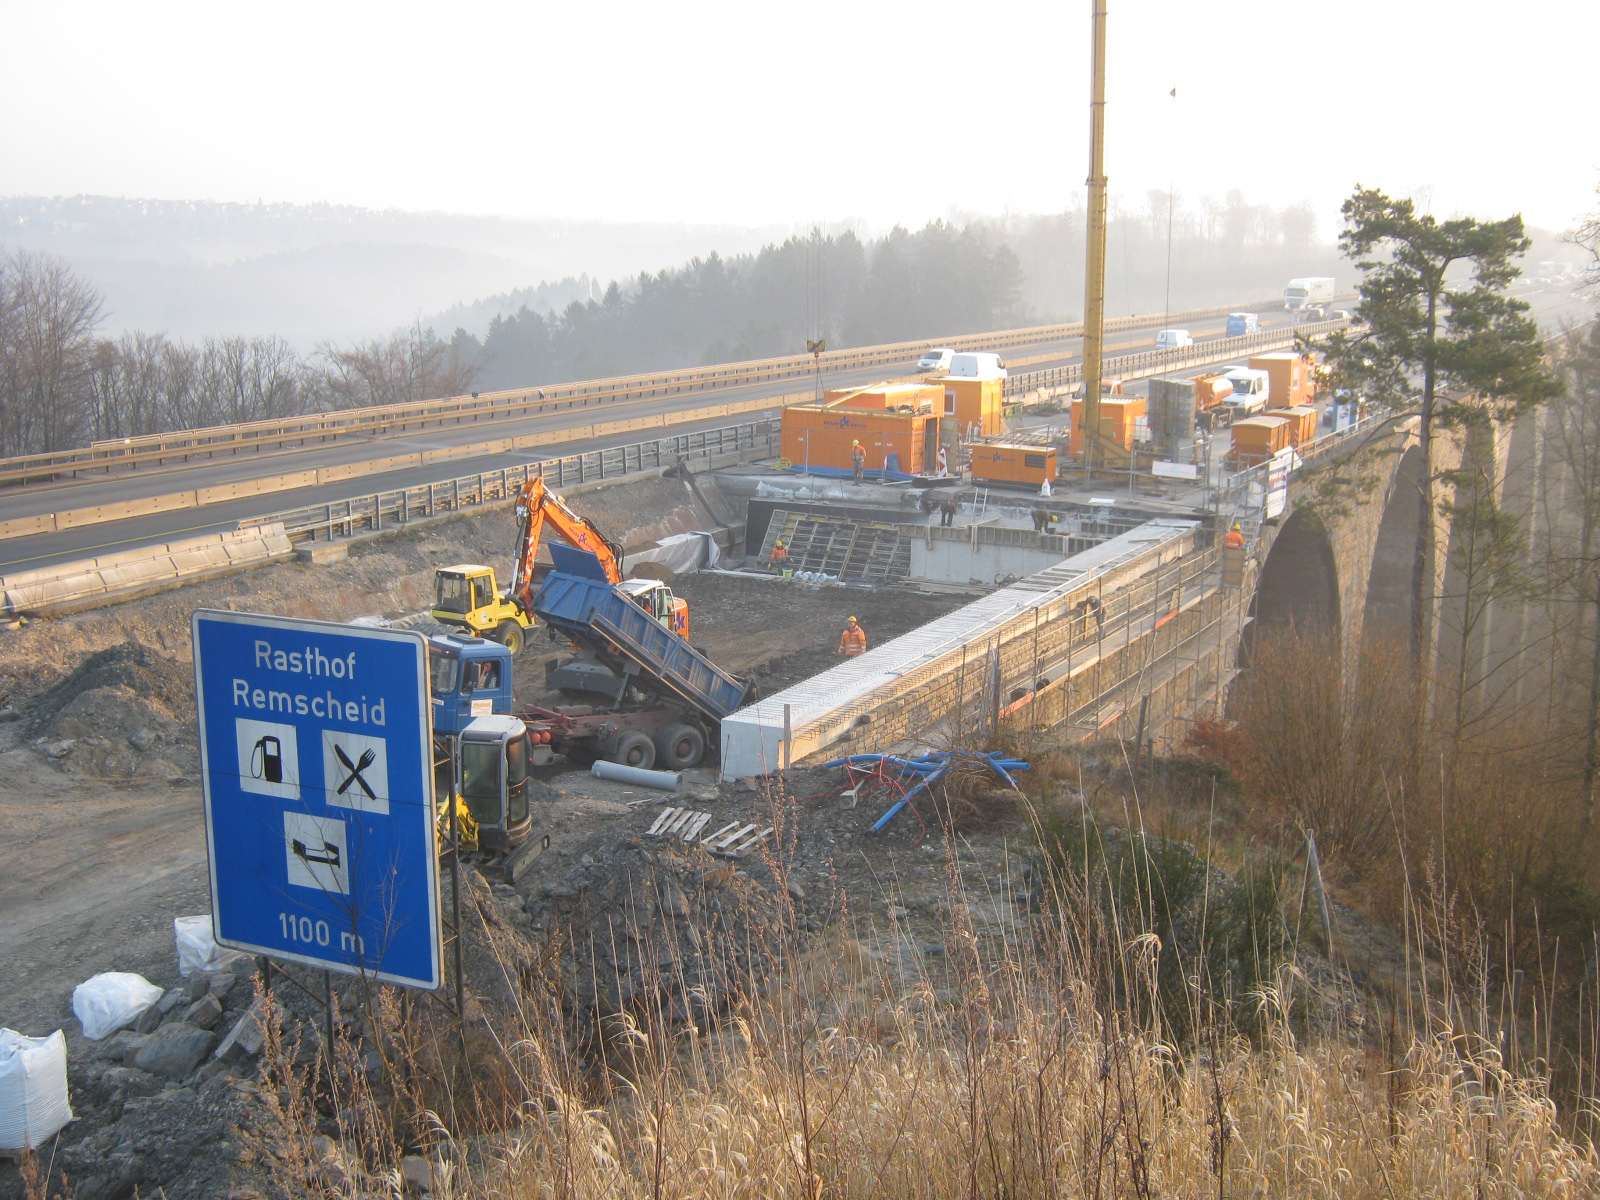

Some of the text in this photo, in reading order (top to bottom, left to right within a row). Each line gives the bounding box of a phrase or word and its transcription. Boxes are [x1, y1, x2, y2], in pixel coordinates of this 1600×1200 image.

[254, 639, 356, 680] Rasthof
[232, 678, 386, 726] Remscheid
[279, 912, 365, 955] 1100 m
